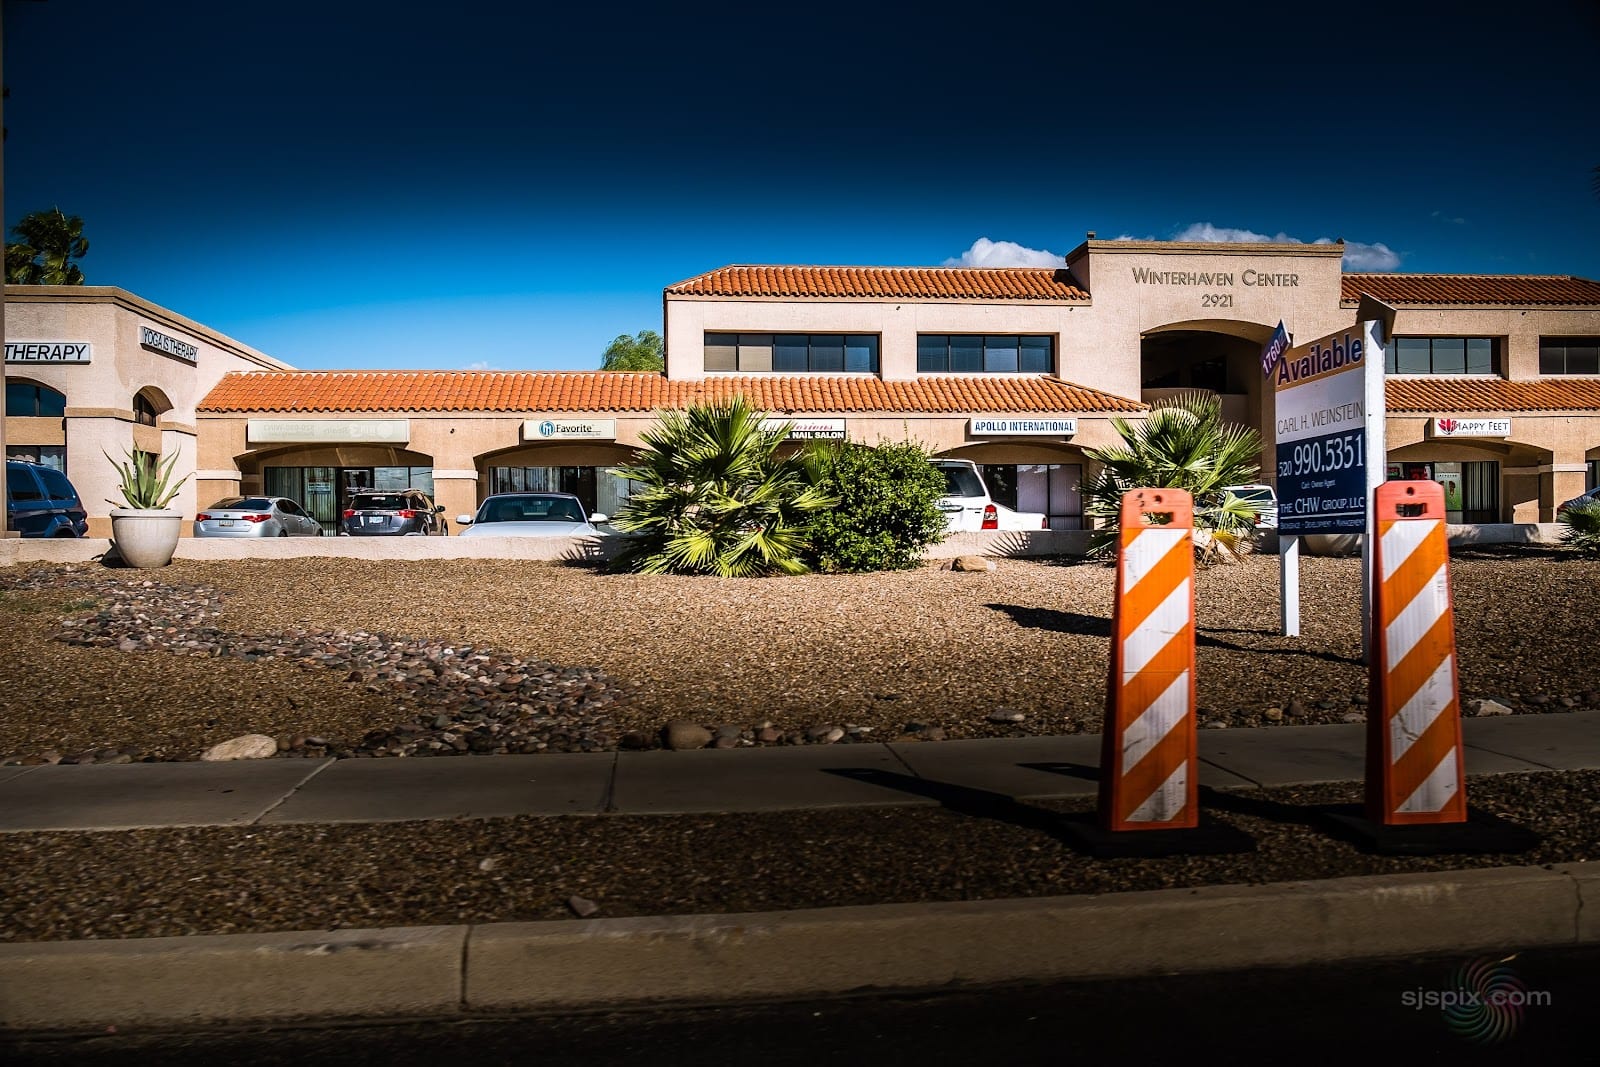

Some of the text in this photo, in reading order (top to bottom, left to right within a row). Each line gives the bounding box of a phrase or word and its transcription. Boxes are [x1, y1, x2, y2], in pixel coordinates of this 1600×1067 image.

[1201, 293, 1233, 307] 2921
[5, 345, 87, 360] THERAPY
[144, 328, 162, 349] YOGA
[170, 339, 198, 361] THERAPY
[1262, 340, 1280, 374] 1760
[1277, 333, 1363, 386] Available
[975, 421, 1074, 432] APOLLO INTERNATIONAL
[1278, 401, 1364, 435] CARL H. WEINSTEIN
[556, 423, 592, 433] Favorite
[792, 431, 813, 439] NAIL
[814, 431, 844, 439] SALON
[1278, 434, 1364, 478] 520 990.5351
[1280, 503, 1293, 514] THE
[1295, 497, 1320, 514] CHW
[1349, 497, 1365, 509] LLC
